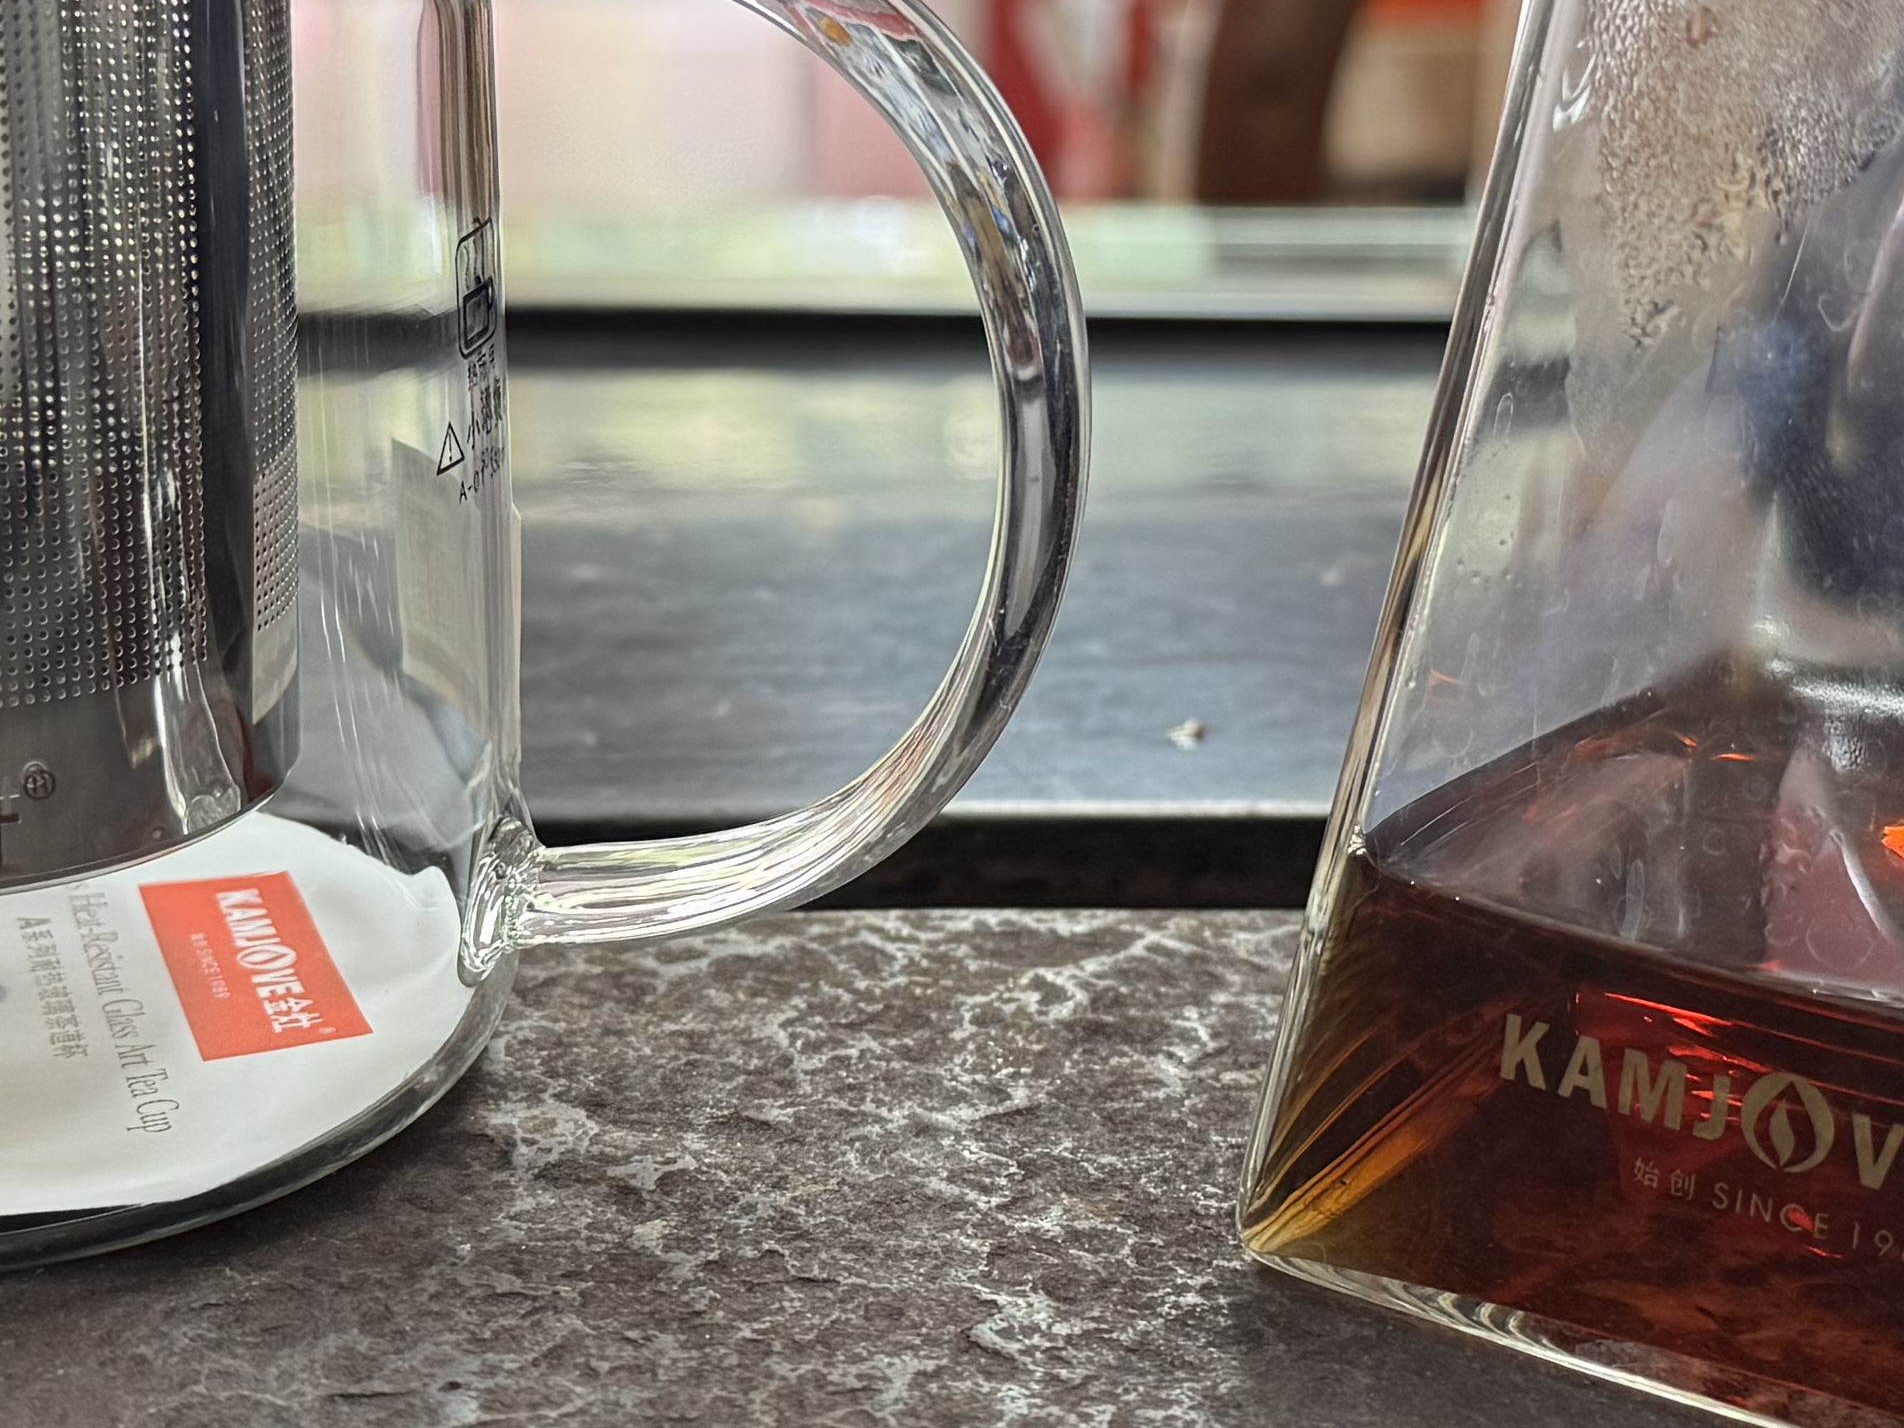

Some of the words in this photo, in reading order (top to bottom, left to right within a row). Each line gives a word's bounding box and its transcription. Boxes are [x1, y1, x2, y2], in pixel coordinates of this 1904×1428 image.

[68, 892, 124, 996] Heat-Resistant
[215, 888, 305, 999] KAMJOVE
[102, 999, 146, 1040] Glass
[114, 1044, 157, 1069] Art
[126, 1068, 169, 1099] Tea
[126, 1099, 180, 1134] Cup
[1632, 1155, 1695, 1201] 始创
[1711, 1181, 1830, 1240] SINCE
